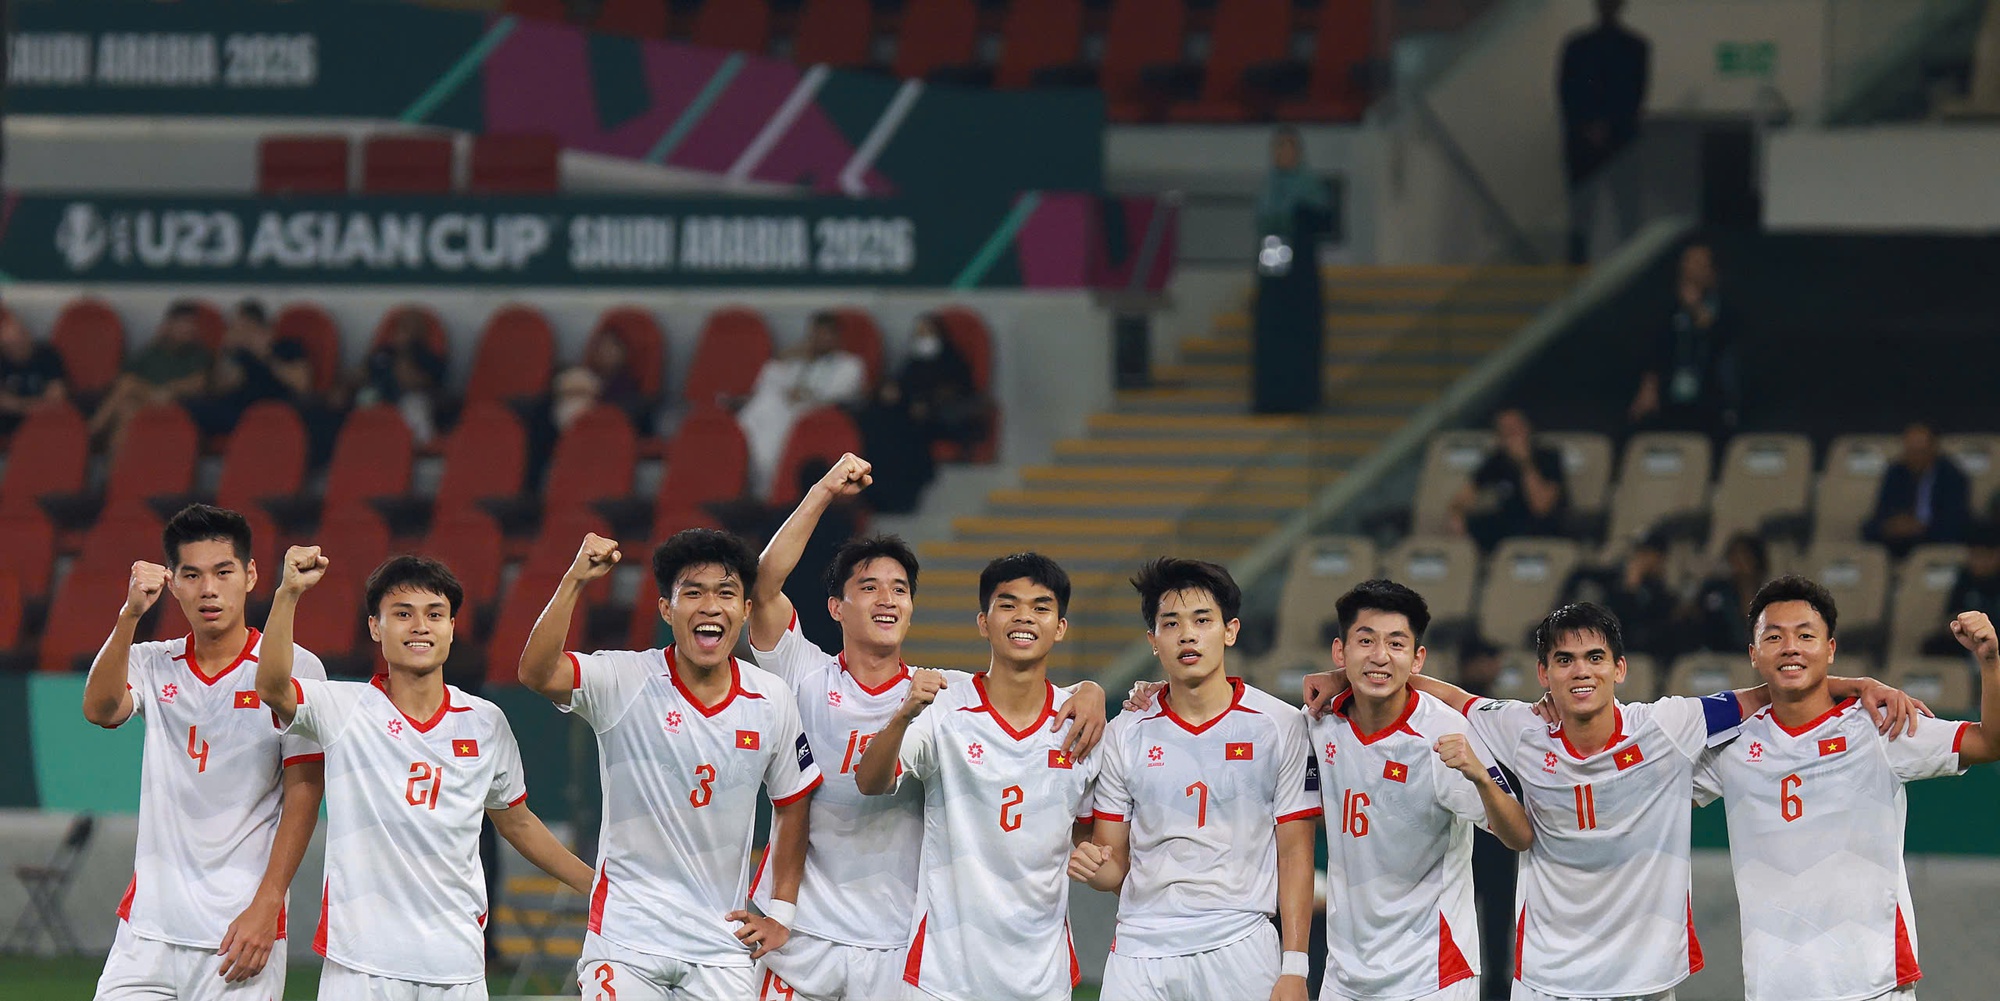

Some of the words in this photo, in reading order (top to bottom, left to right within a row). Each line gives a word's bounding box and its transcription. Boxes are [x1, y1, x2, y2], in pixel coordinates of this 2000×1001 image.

[97, 33, 218, 85] ARABIA
[225, 34, 316, 86] 2026
[135, 210, 243, 266] U23
[249, 212, 422, 270] ASIAN
[427, 213, 549, 271] CUP
[570, 215, 674, 270] SAUDI
[680, 216, 808, 271] ARABIA
[816, 217, 915, 272] 2026
[187, 725, 210, 773] 4
[405, 762, 442, 811] 21
[689, 763, 716, 808] 3
[999, 784, 1024, 833] 2
[1186, 781, 1208, 829] 7
[1574, 784, 1597, 831] 11
[1780, 773, 1803, 823] 6
[1343, 788, 1371, 838] 16
[594, 963, 617, 1001] 3
